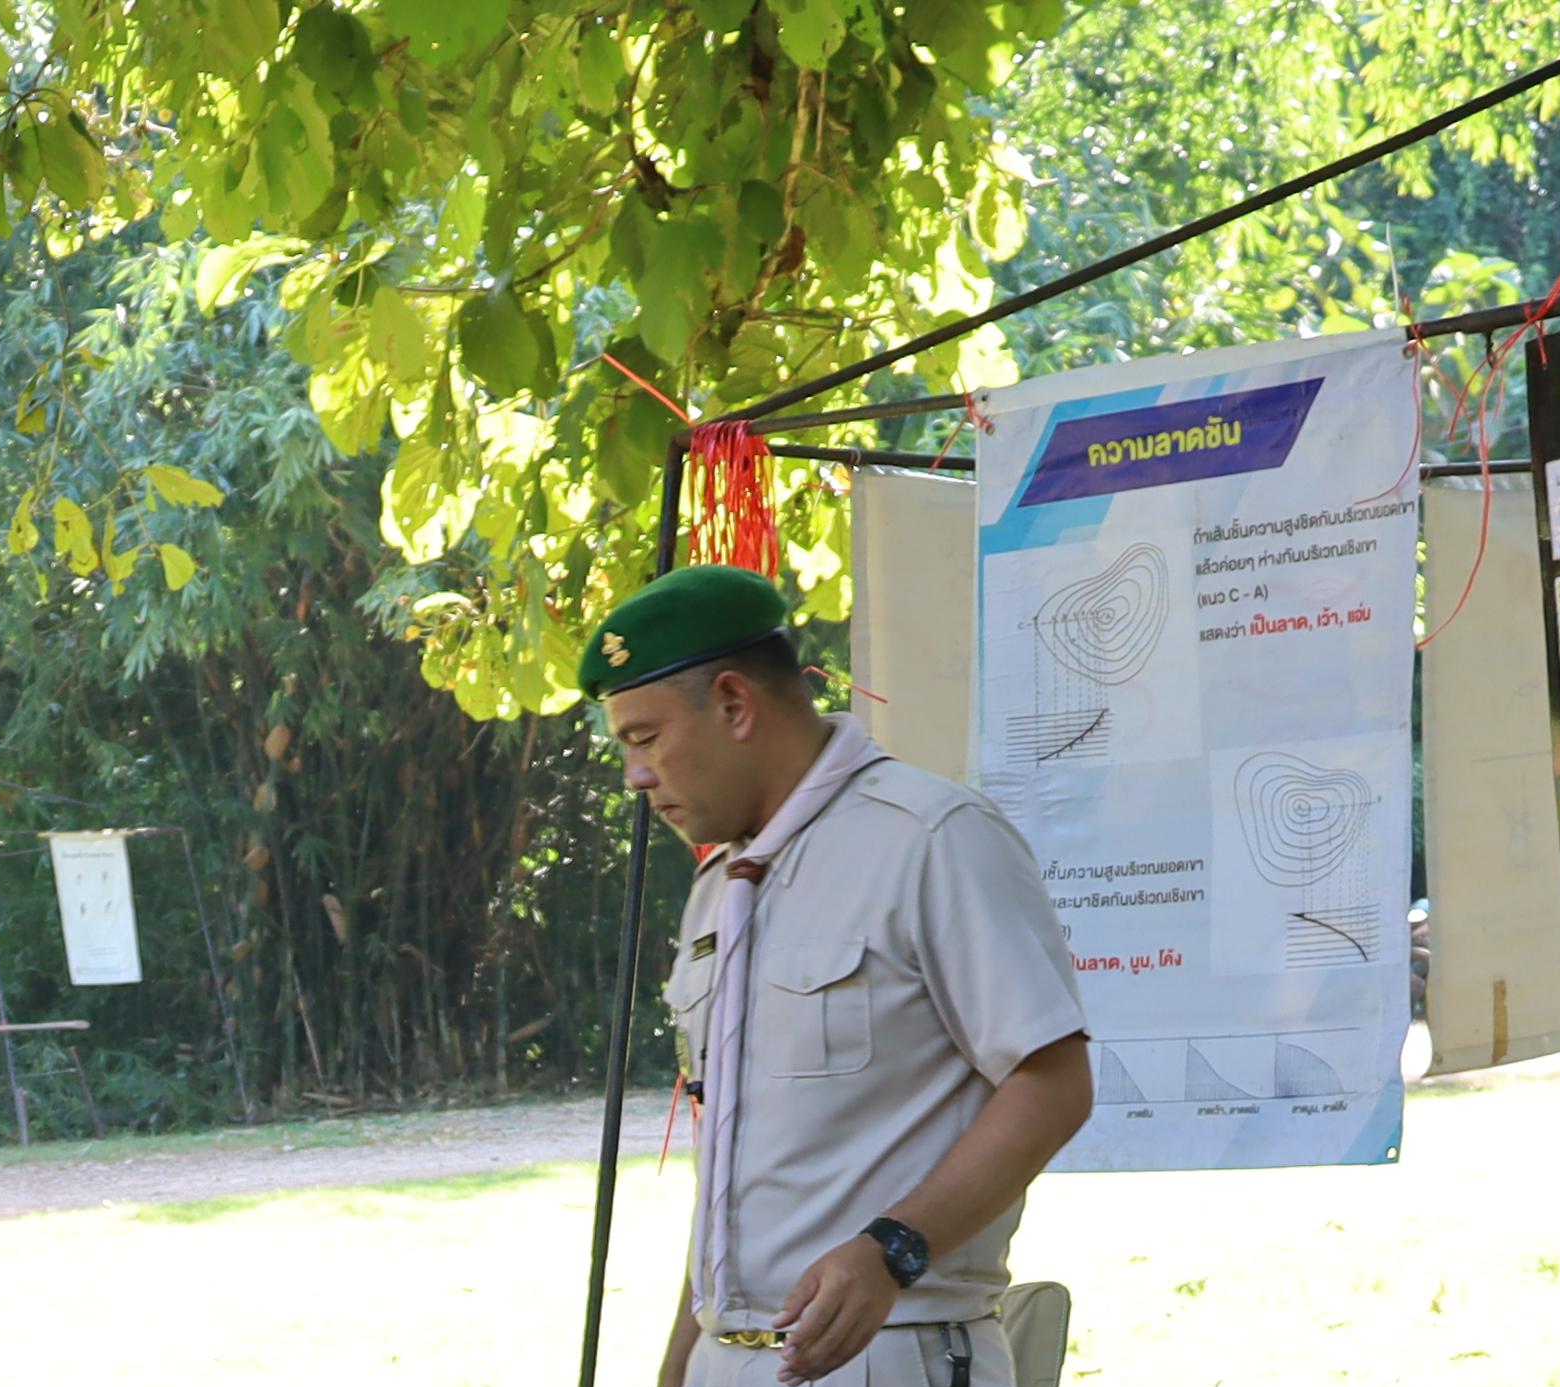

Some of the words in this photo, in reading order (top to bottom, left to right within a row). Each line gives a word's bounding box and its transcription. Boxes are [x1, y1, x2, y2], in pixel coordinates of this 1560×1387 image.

[1087, 416, 1242, 467] ความลาดชัน
[1229, 588, 1240, 602] C
[1253, 584, 1269, 601] A)
